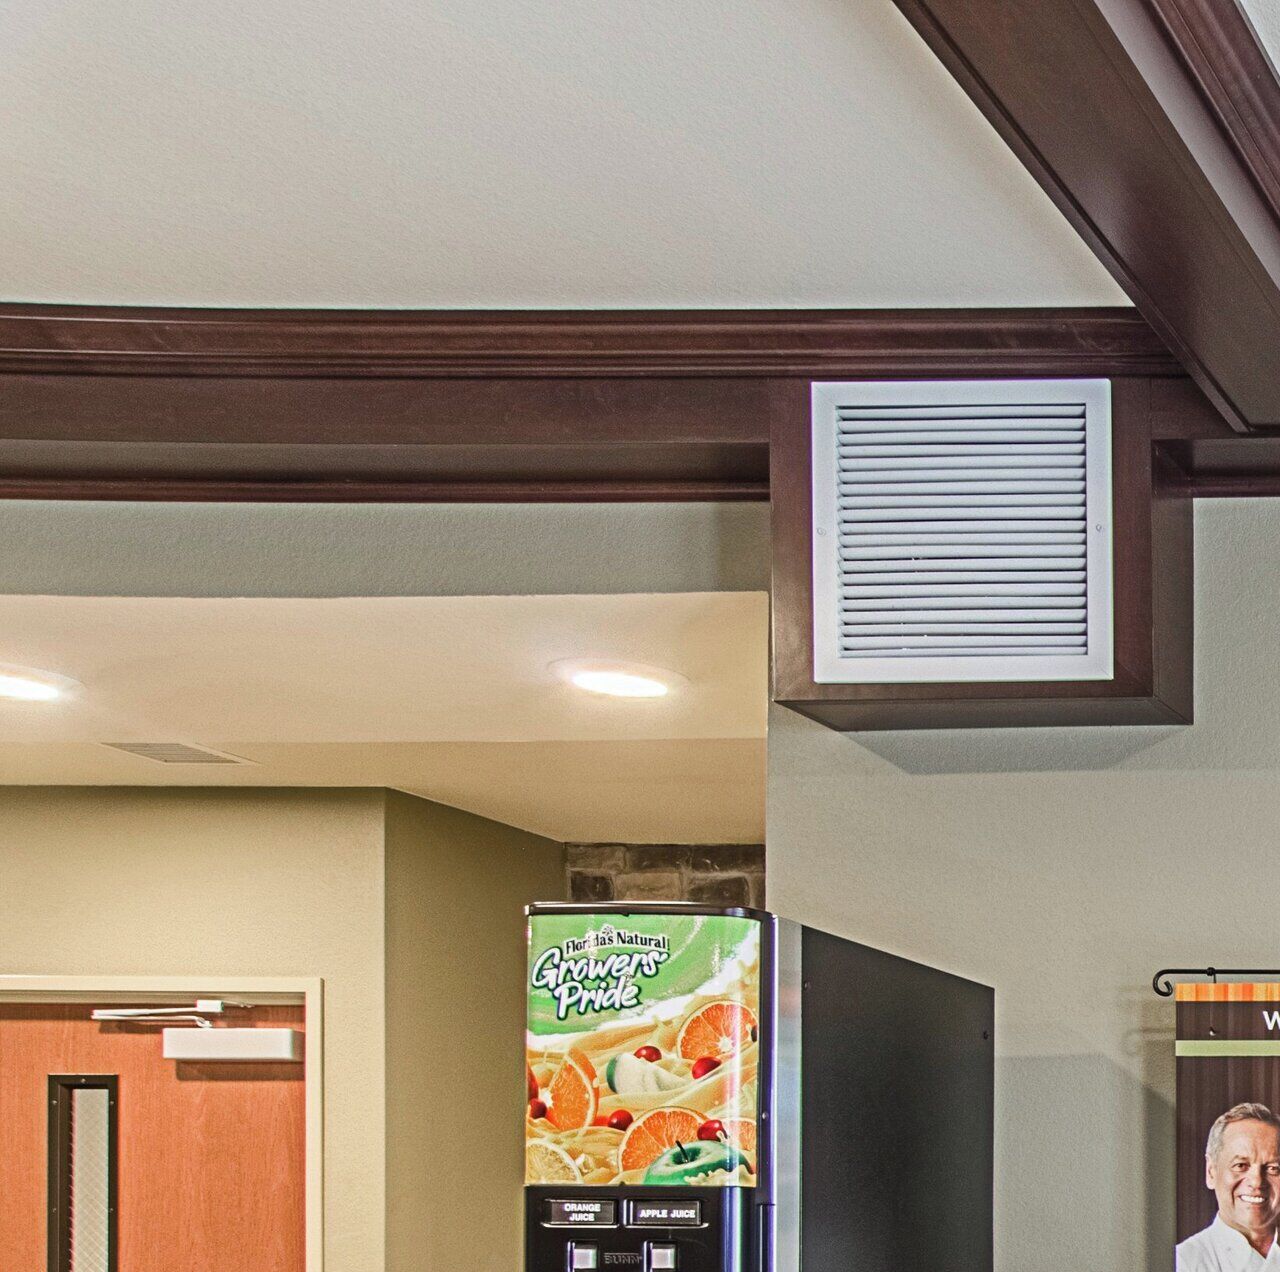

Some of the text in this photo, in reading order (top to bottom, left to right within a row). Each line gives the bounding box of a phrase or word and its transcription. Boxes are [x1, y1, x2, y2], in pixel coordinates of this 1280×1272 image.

[553, 974, 641, 1020] Pride
[563, 1202, 601, 1212] ORANGE
[568, 1212, 595, 1221] JUICE
[639, 1209, 696, 1218] APPLE JUICE
